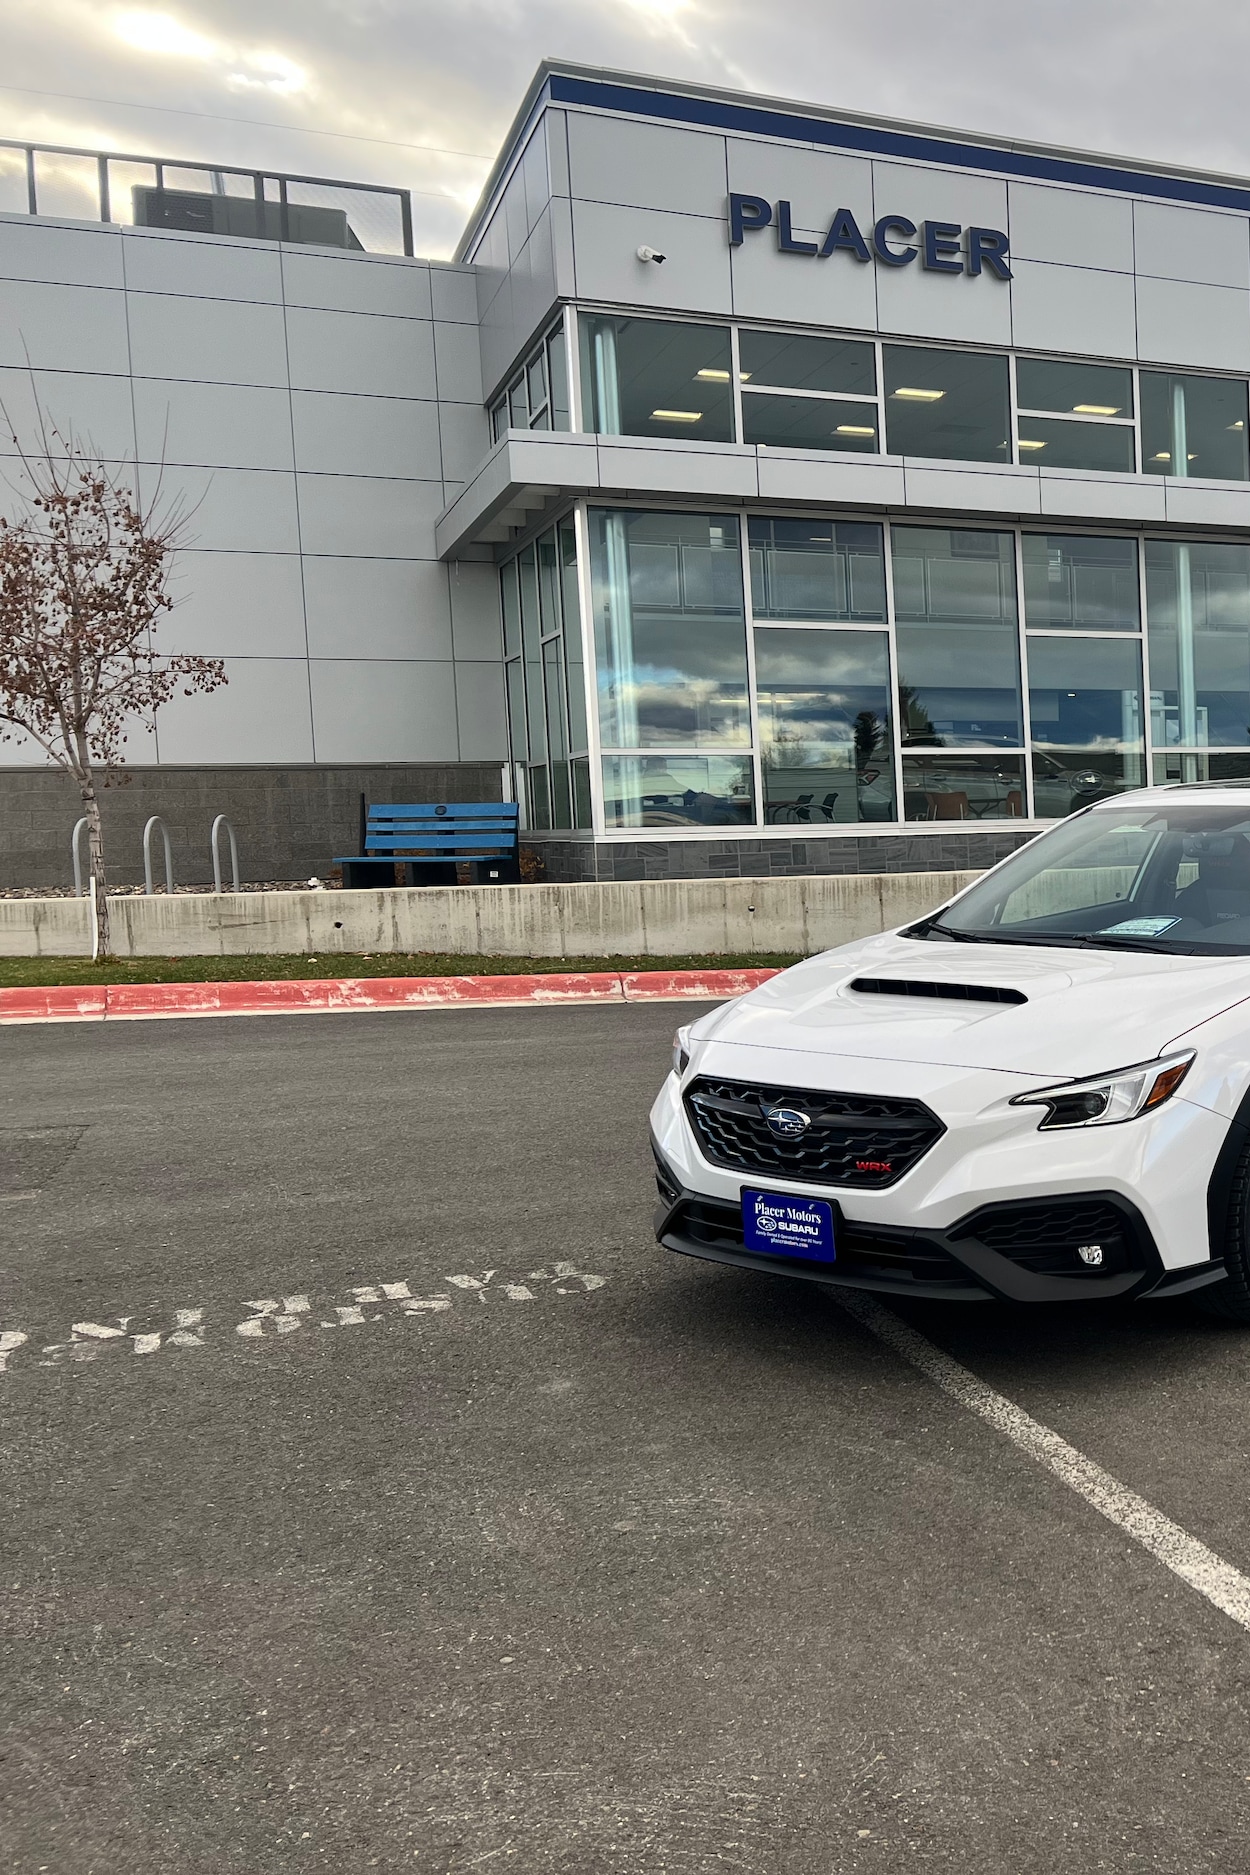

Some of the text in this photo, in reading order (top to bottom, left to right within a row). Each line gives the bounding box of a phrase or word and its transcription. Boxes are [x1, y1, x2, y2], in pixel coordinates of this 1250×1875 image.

[728, 192, 1014, 280] PLACER
[855, 1160, 893, 1172] WRX
[754, 1202, 822, 1225] Placer Motors
[778, 1221, 819, 1236] SUBARU
[0, 1273, 608, 1371] CUSTOME
